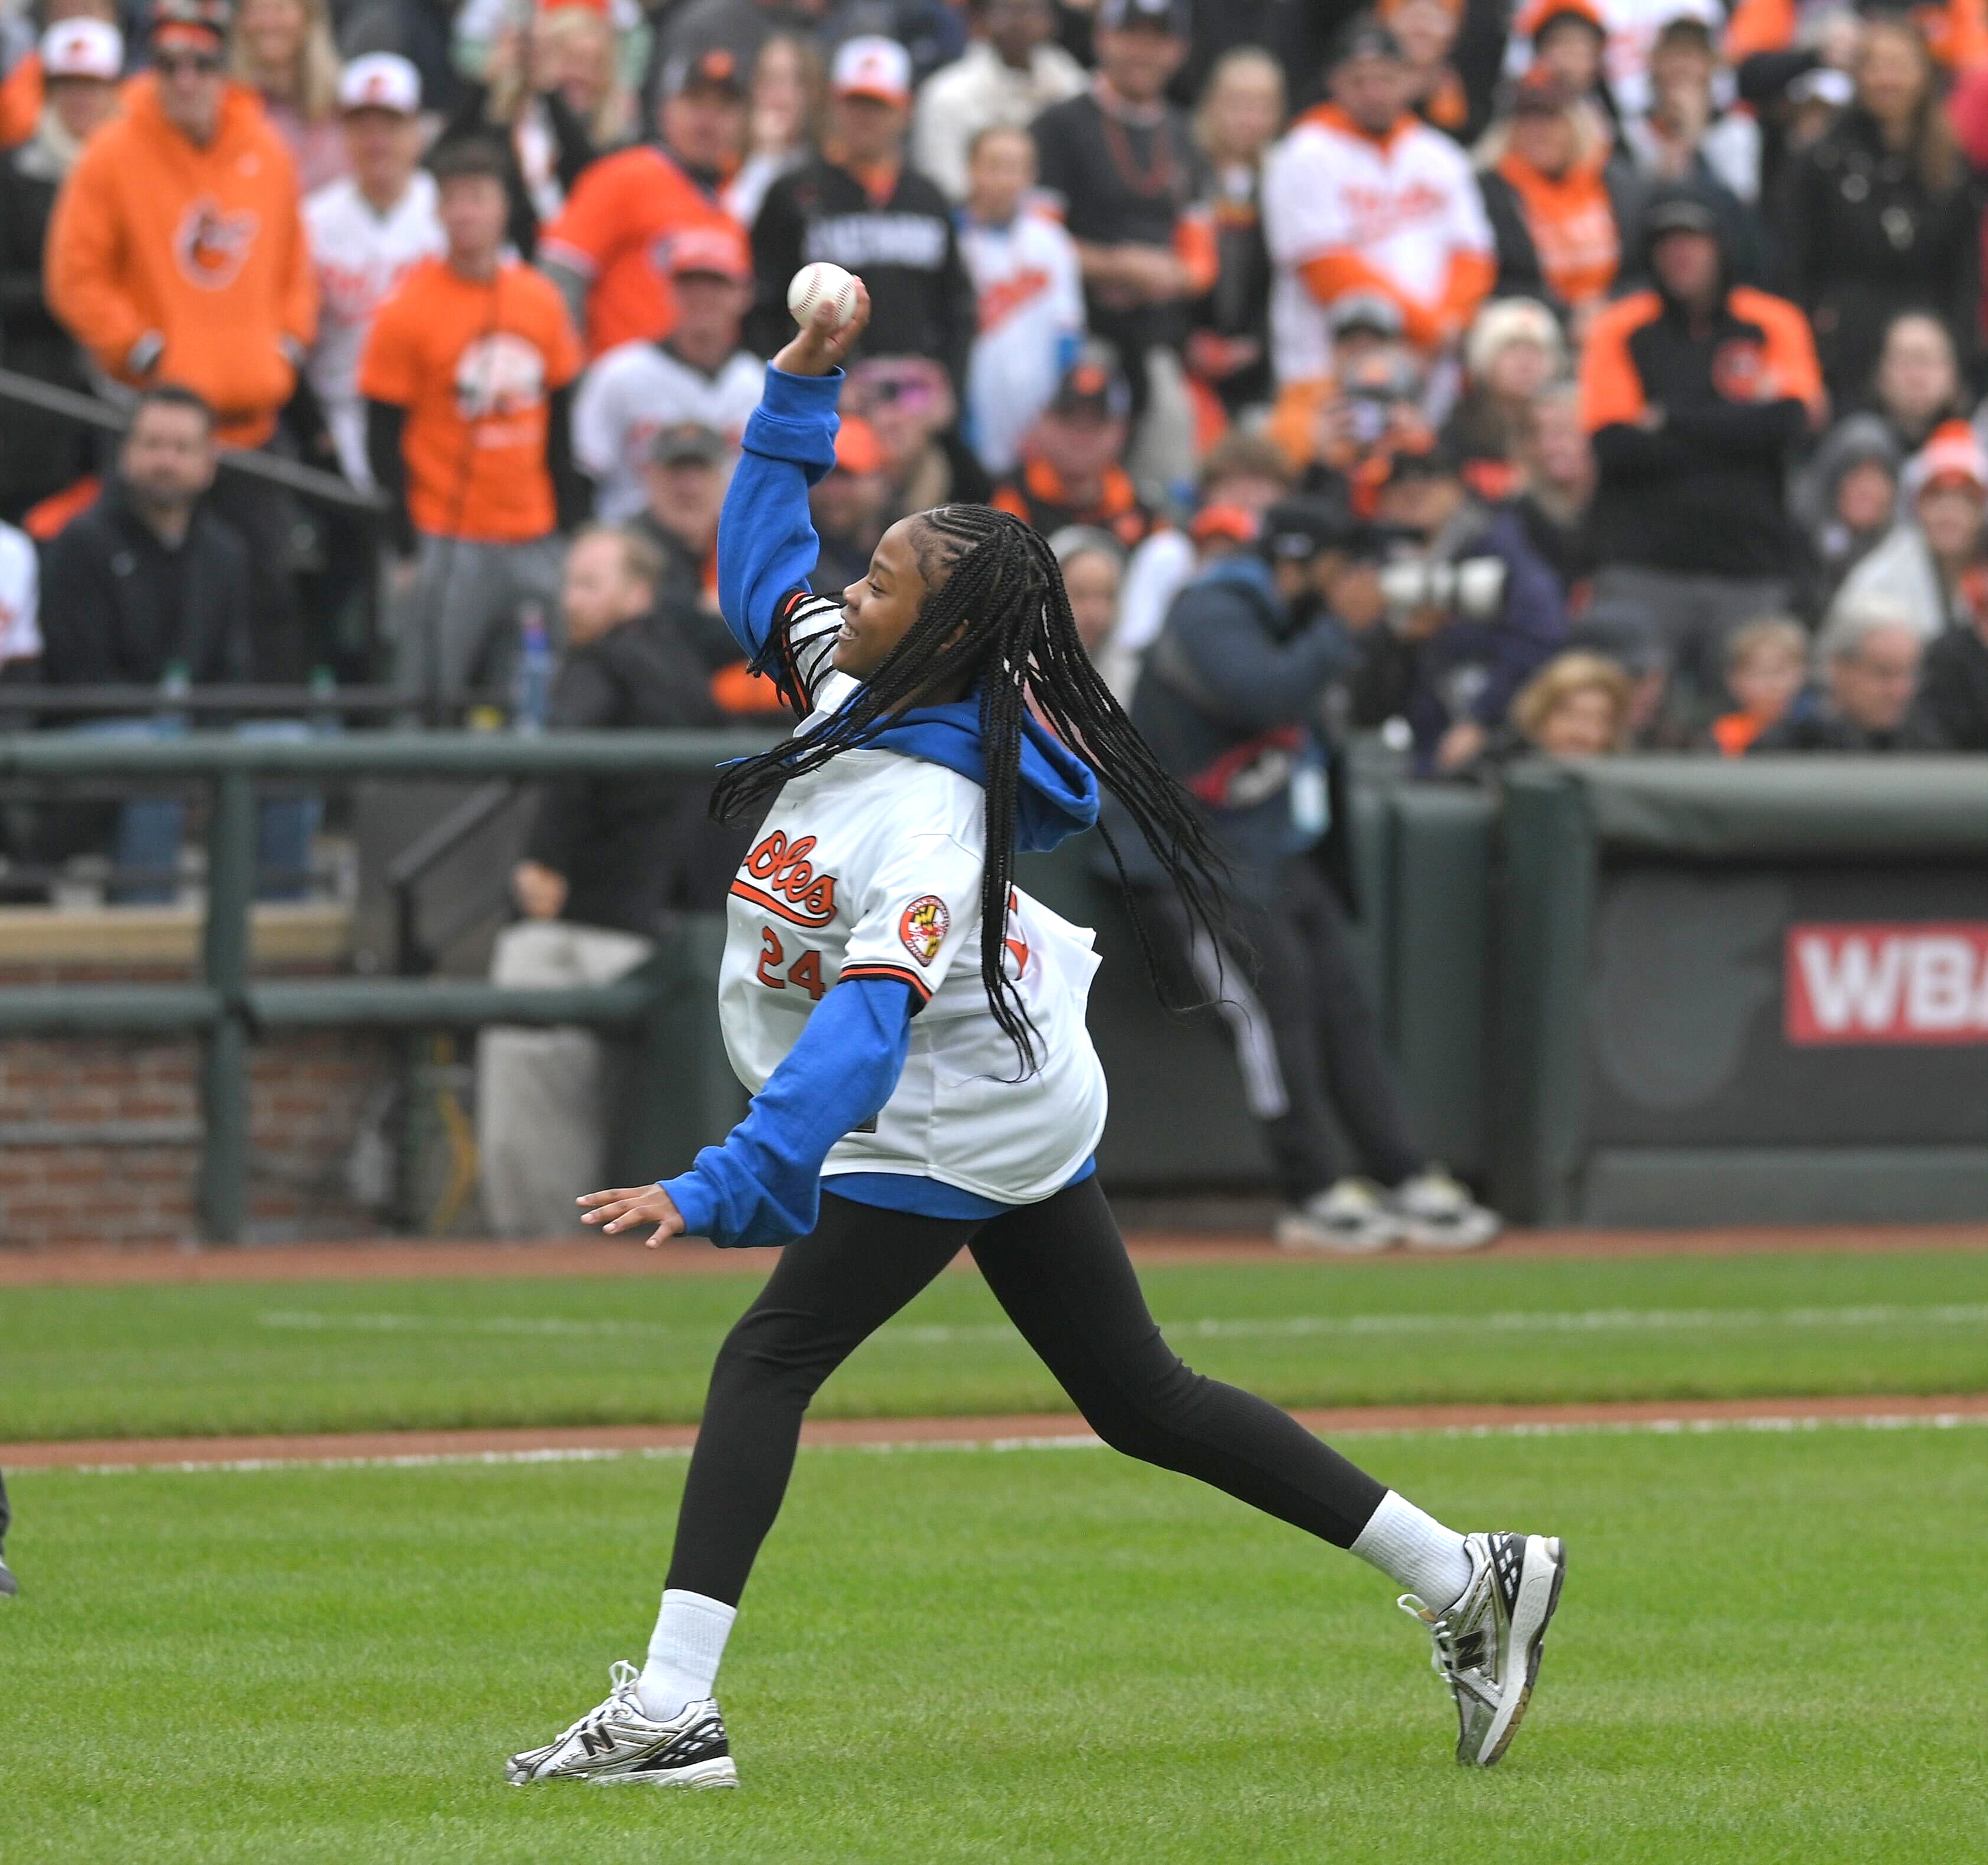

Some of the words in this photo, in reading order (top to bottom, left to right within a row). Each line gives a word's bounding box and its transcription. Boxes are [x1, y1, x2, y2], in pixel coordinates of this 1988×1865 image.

[743, 830, 838, 915] oles
[757, 926, 826, 1000] 24
[1796, 933, 1988, 1032] WB
[578, 1721, 618, 1760] N
